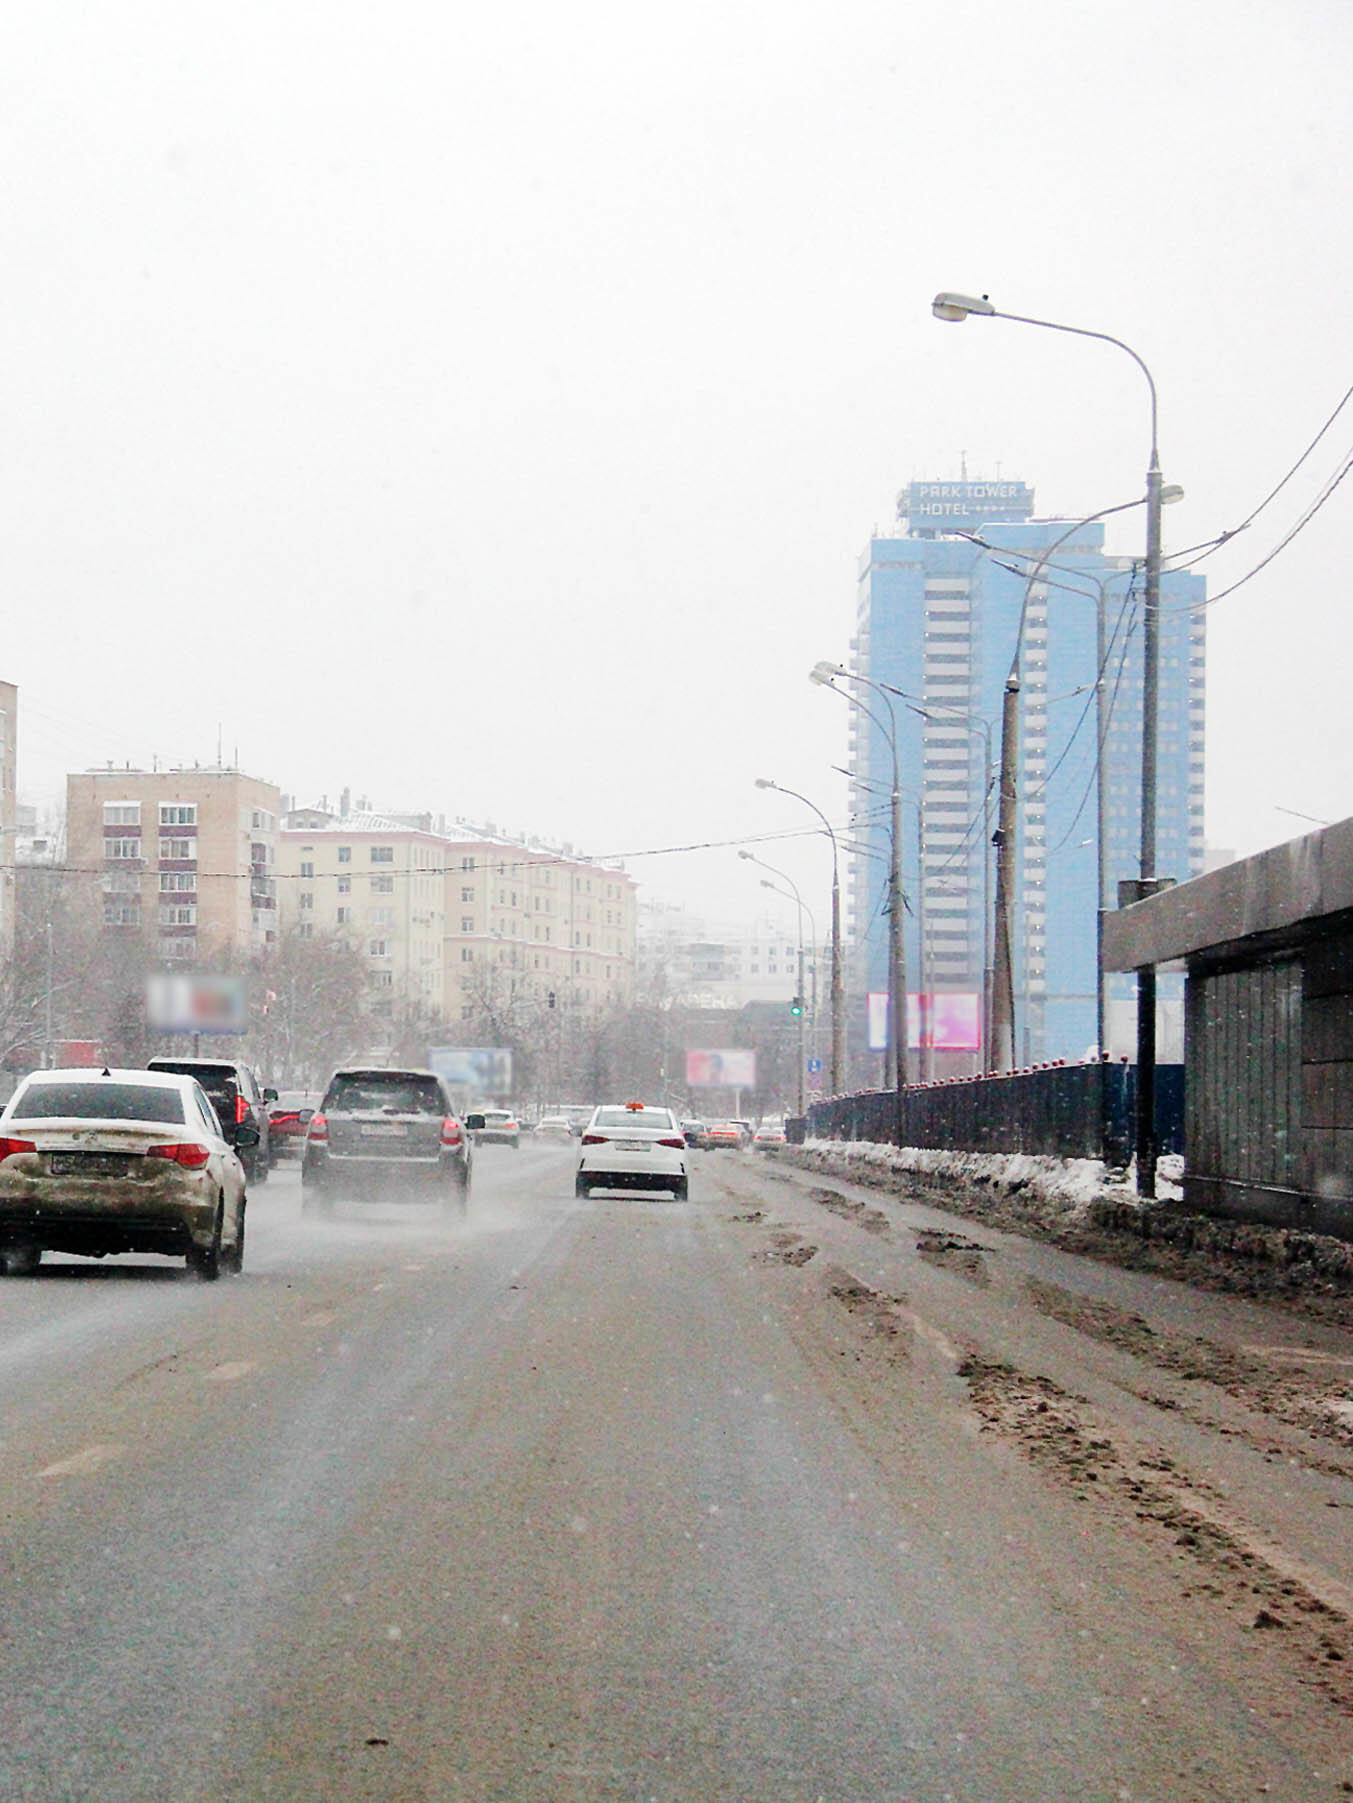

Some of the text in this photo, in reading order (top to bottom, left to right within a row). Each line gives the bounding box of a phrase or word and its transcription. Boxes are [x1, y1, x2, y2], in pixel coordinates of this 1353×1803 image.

[919, 484, 1018, 498] PARK TOWER
[919, 503, 969, 516] HOTEL
